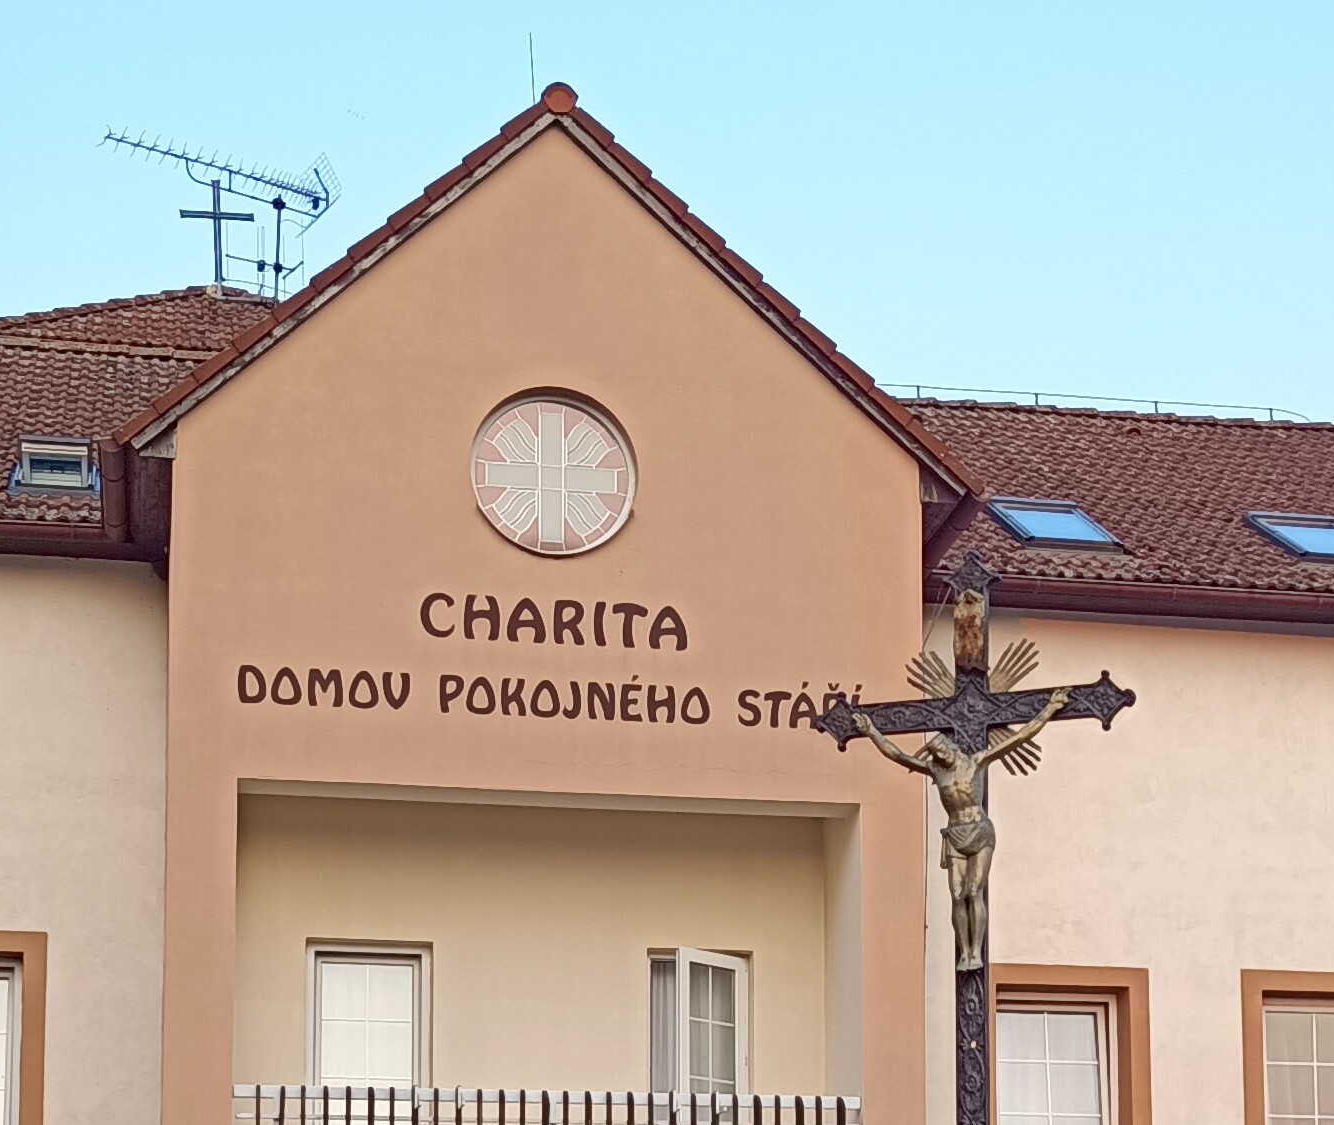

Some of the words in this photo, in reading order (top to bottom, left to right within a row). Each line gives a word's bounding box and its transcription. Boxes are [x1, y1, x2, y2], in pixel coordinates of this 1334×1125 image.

[420, 593, 687, 651] CHARITA
[238, 665, 410, 710] DOMOV
[440, 675, 710, 724] POKOJNÉHO
